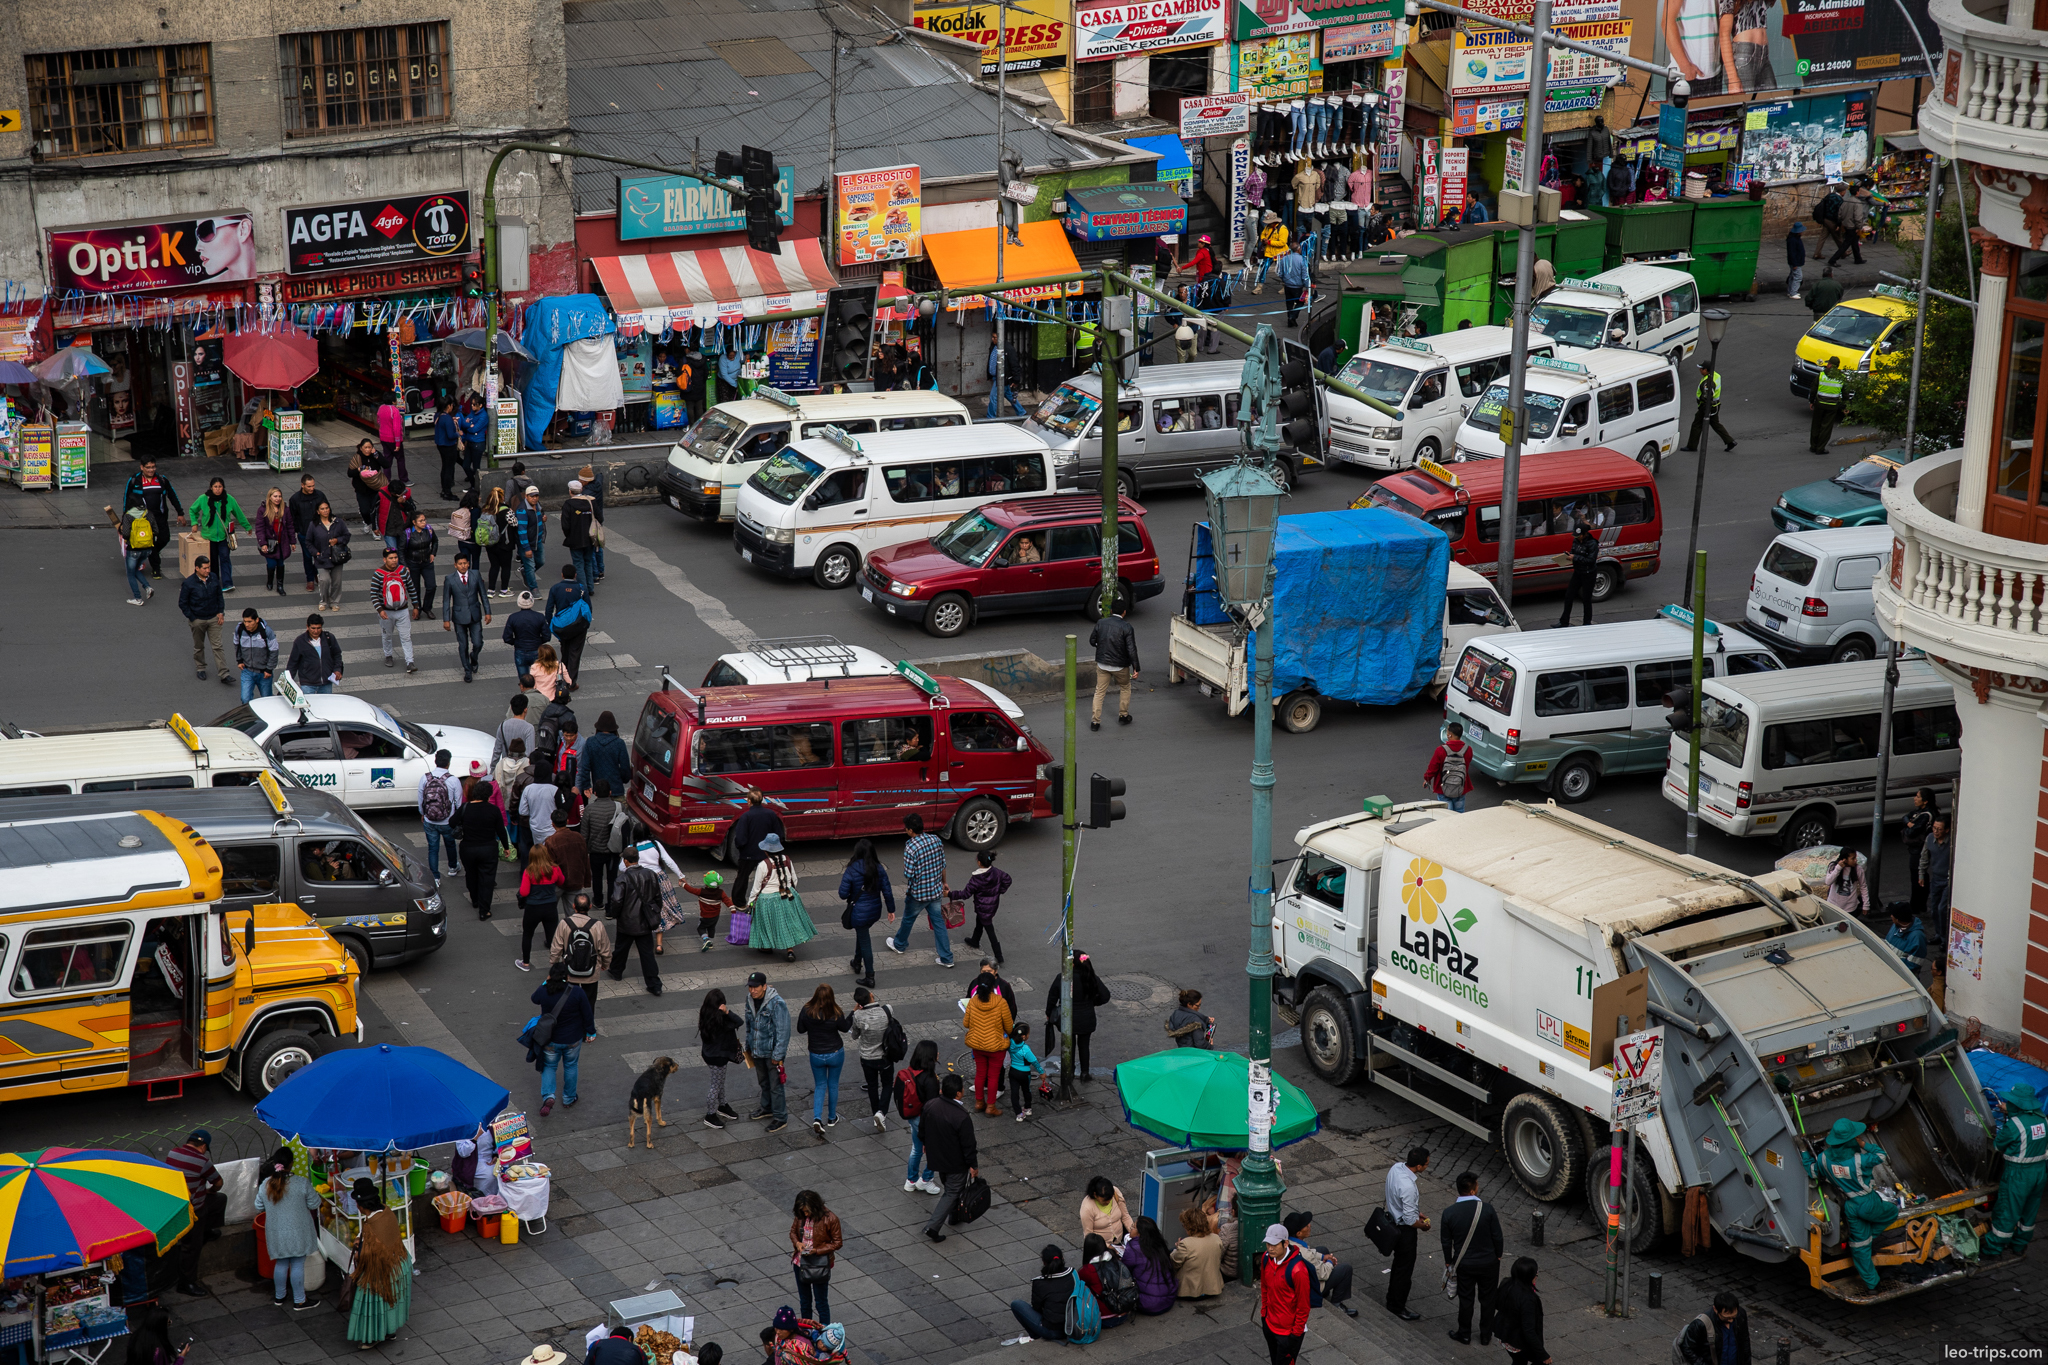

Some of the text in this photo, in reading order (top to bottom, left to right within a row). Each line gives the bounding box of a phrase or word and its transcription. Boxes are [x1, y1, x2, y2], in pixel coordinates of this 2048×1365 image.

[1081, 0, 1221, 27] CASA DE CAMBIOS
[1470, 4, 1535, 16] TECNICO
[1797, 1, 1818, 13] 2da.
[928, 12, 986, 33] Kodak
[1804, 11, 1840, 20] INSCRIPCIONES:
[1132, 23, 1163, 37] Divisa
[1250, 10, 1392, 36] ESTUDIO FOTOGRAFICO DIGITAL
[1803, 16, 1862, 33] ABIERTAS
[1022, 42, 1058, 52] CONTROLADA
[1086, 31, 1215, 55] MONEY EXCHANGE
[1592, 37, 1629, 46] TARJETAS
[999, 59, 1042, 71] IGITALES
[1810, 60, 1852, 72] 611 24000
[302, 62, 440, 92] ABOGADO
[1242, 80, 1307, 101] FUJICOLOR
[1454, 86, 1489, 95] RECARGAS
[1184, 95, 1246, 109] CASA DE CAMBIOS
[1545, 96, 1596, 112] CHAMARRAS
[1851, 102, 1864, 111] 3M
[1505, 121, 1519, 129] BCP
[1234, 149, 1248, 184] MONEY
[842, 170, 912, 186] EL SABROSITO
[847, 192, 875, 200] SANDWICH
[888, 197, 920, 207] CHORIPAN
[1092, 212, 1140, 226] SERVICIO
[1233, 185, 1247, 239] EXCHANGE
[290, 210, 368, 245] AGFA
[375, 215, 404, 229] Agfa
[703, 221, 735, 230] EFICACIA
[882, 222, 912, 231] SANDWICH
[1110, 222, 1170, 236] CELULARES
[427, 233, 457, 245] TOTTO
[68, 231, 187, 282] Opti.K
[185, 264, 202, 275] vip
[136, 278, 168, 287] diferente
[291, 264, 457, 299] DIGITAL PHOTO SERVICE
[717, 302, 742, 311] Eucerin
[766, 297, 791, 307] Eucerin
[668, 307, 693, 317] Eucerin
[1437, 510, 1462, 520] VOLVERE
[1761, 592, 1800, 615] purecotton
[706, 715, 747, 724] FALKEN
[345, 915, 369, 923] SUPER
[1400, 914, 1478, 984] LaPaz
[1391, 949, 1489, 1009] eco eficiente
[1576, 965, 1602, 999] 11
[1539, 1013, 1560, 1037] LPL
[1565, 1030, 1589, 1048] Siremu
[2032, 1124, 2046, 1137] LPL
[1831, 1164, 1851, 1178] LPL
